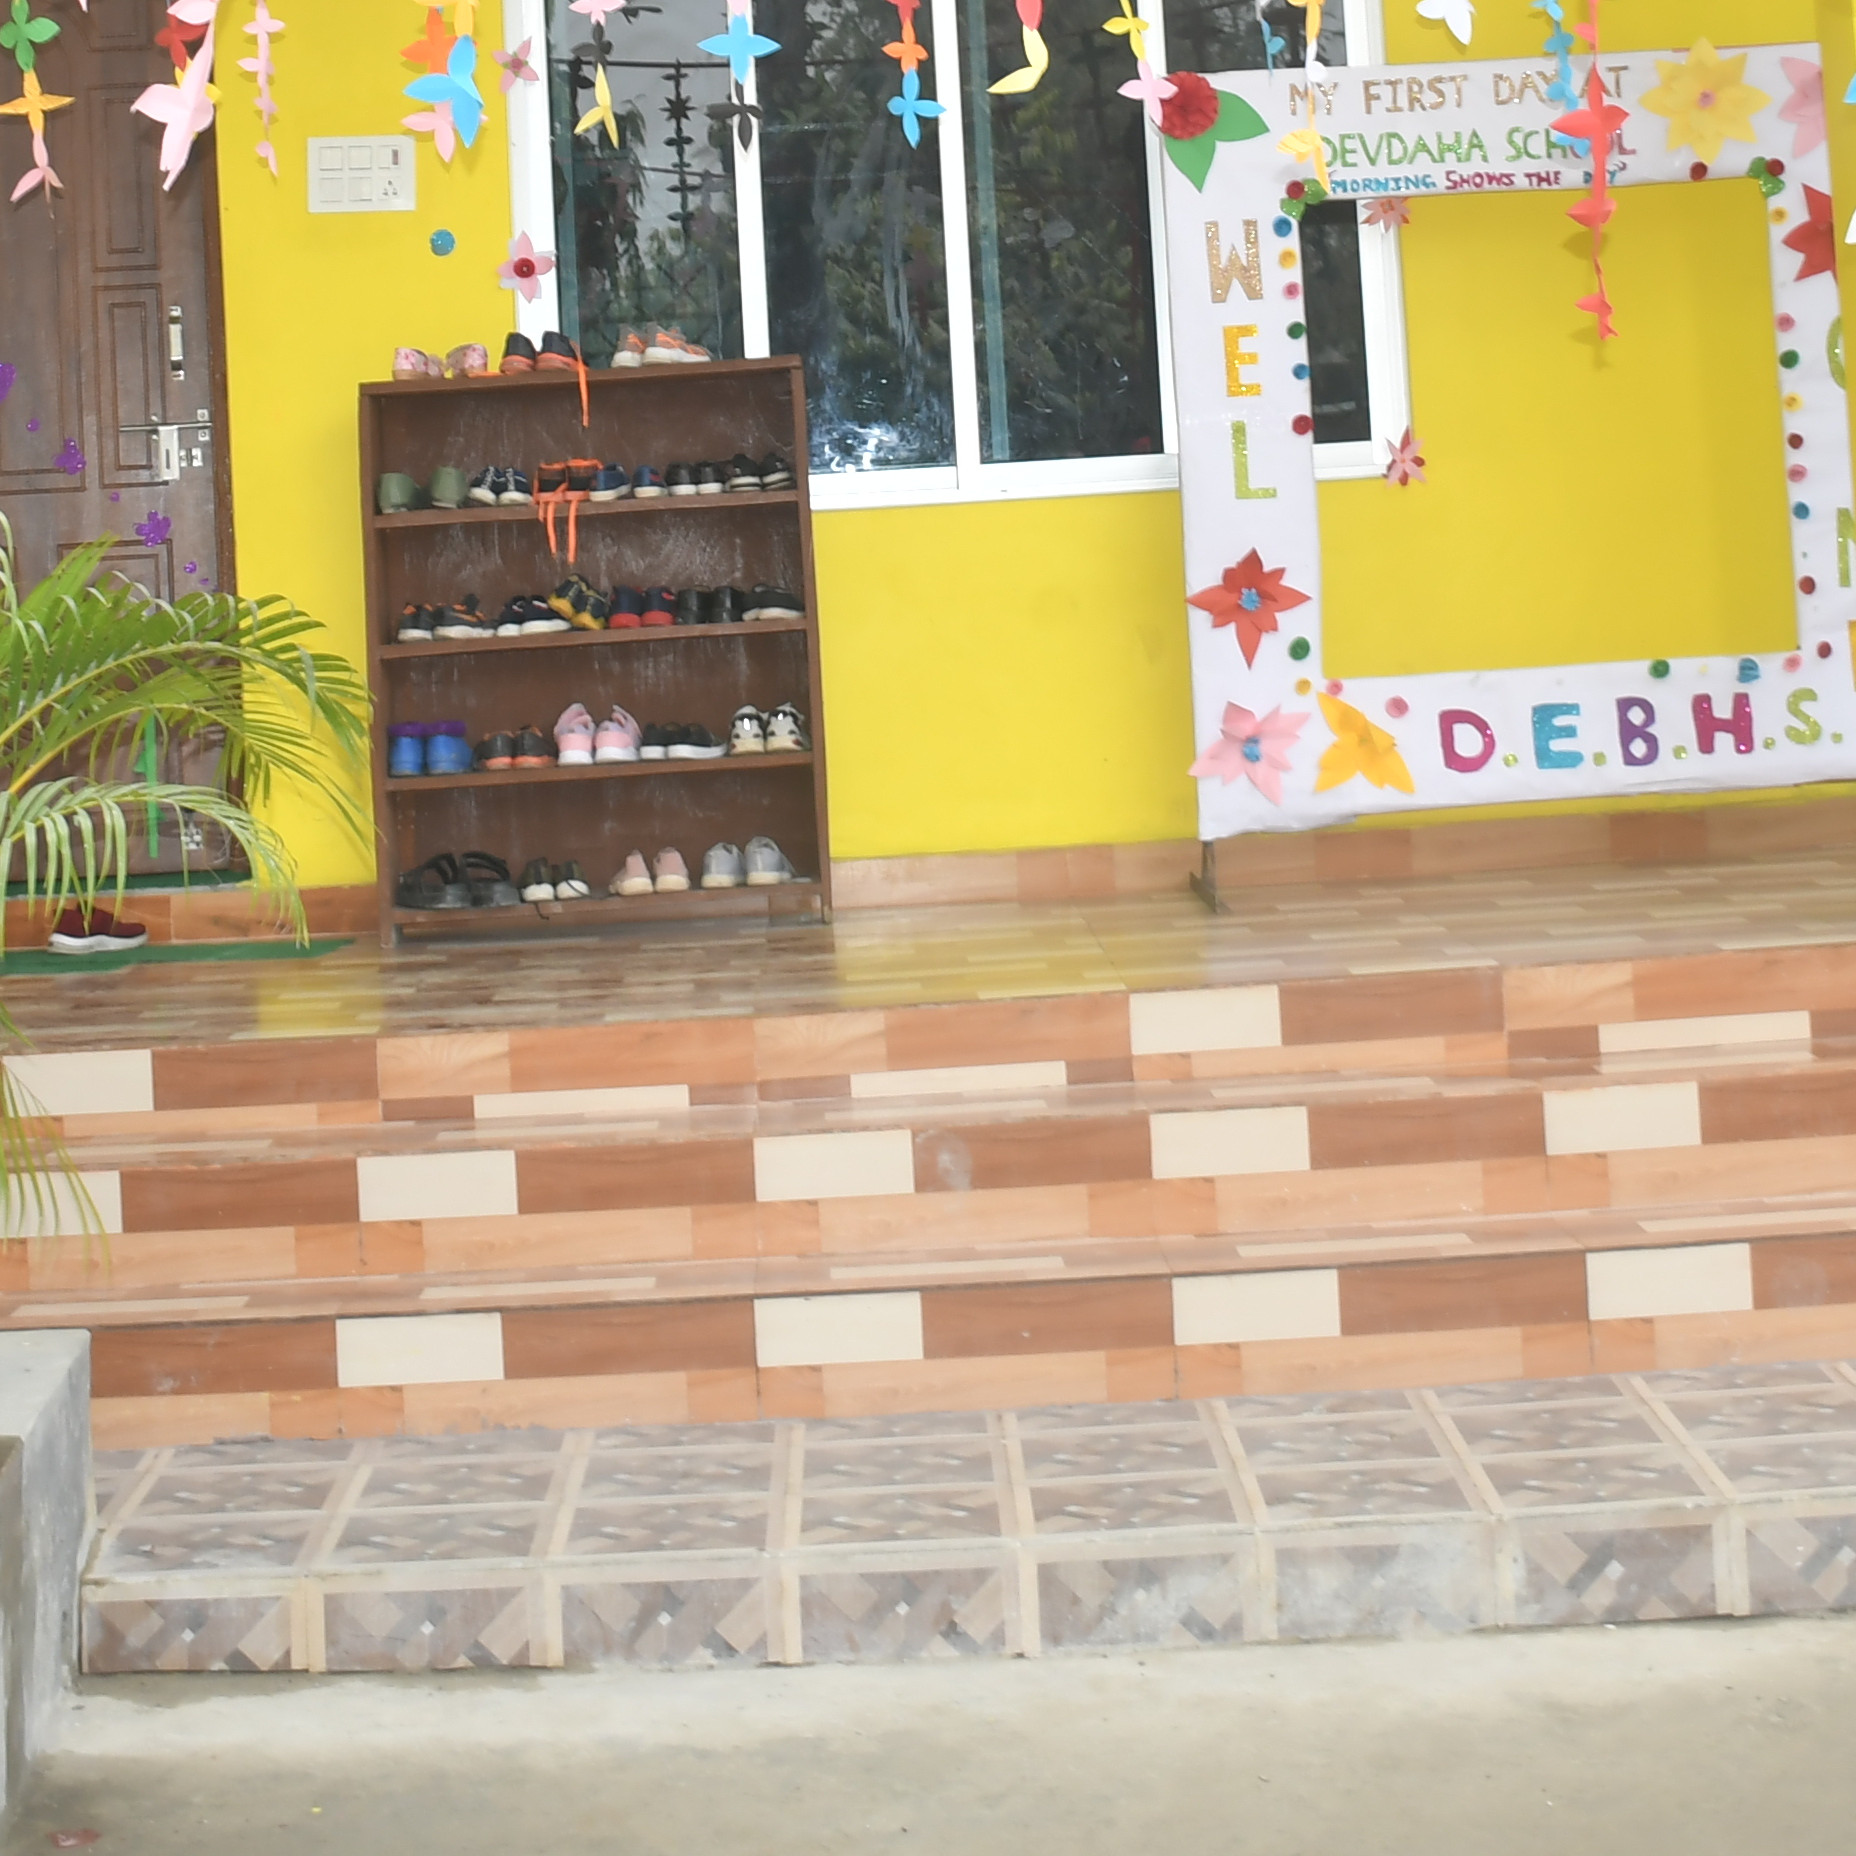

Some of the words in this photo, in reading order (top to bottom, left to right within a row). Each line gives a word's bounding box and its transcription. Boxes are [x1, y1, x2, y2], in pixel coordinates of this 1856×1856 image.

[1289, 82, 1338, 115] MY
[1362, 74, 1468, 114] FIRST
[1445, 170, 1515, 190] SHOWS
[1524, 171, 1561, 186] THE
